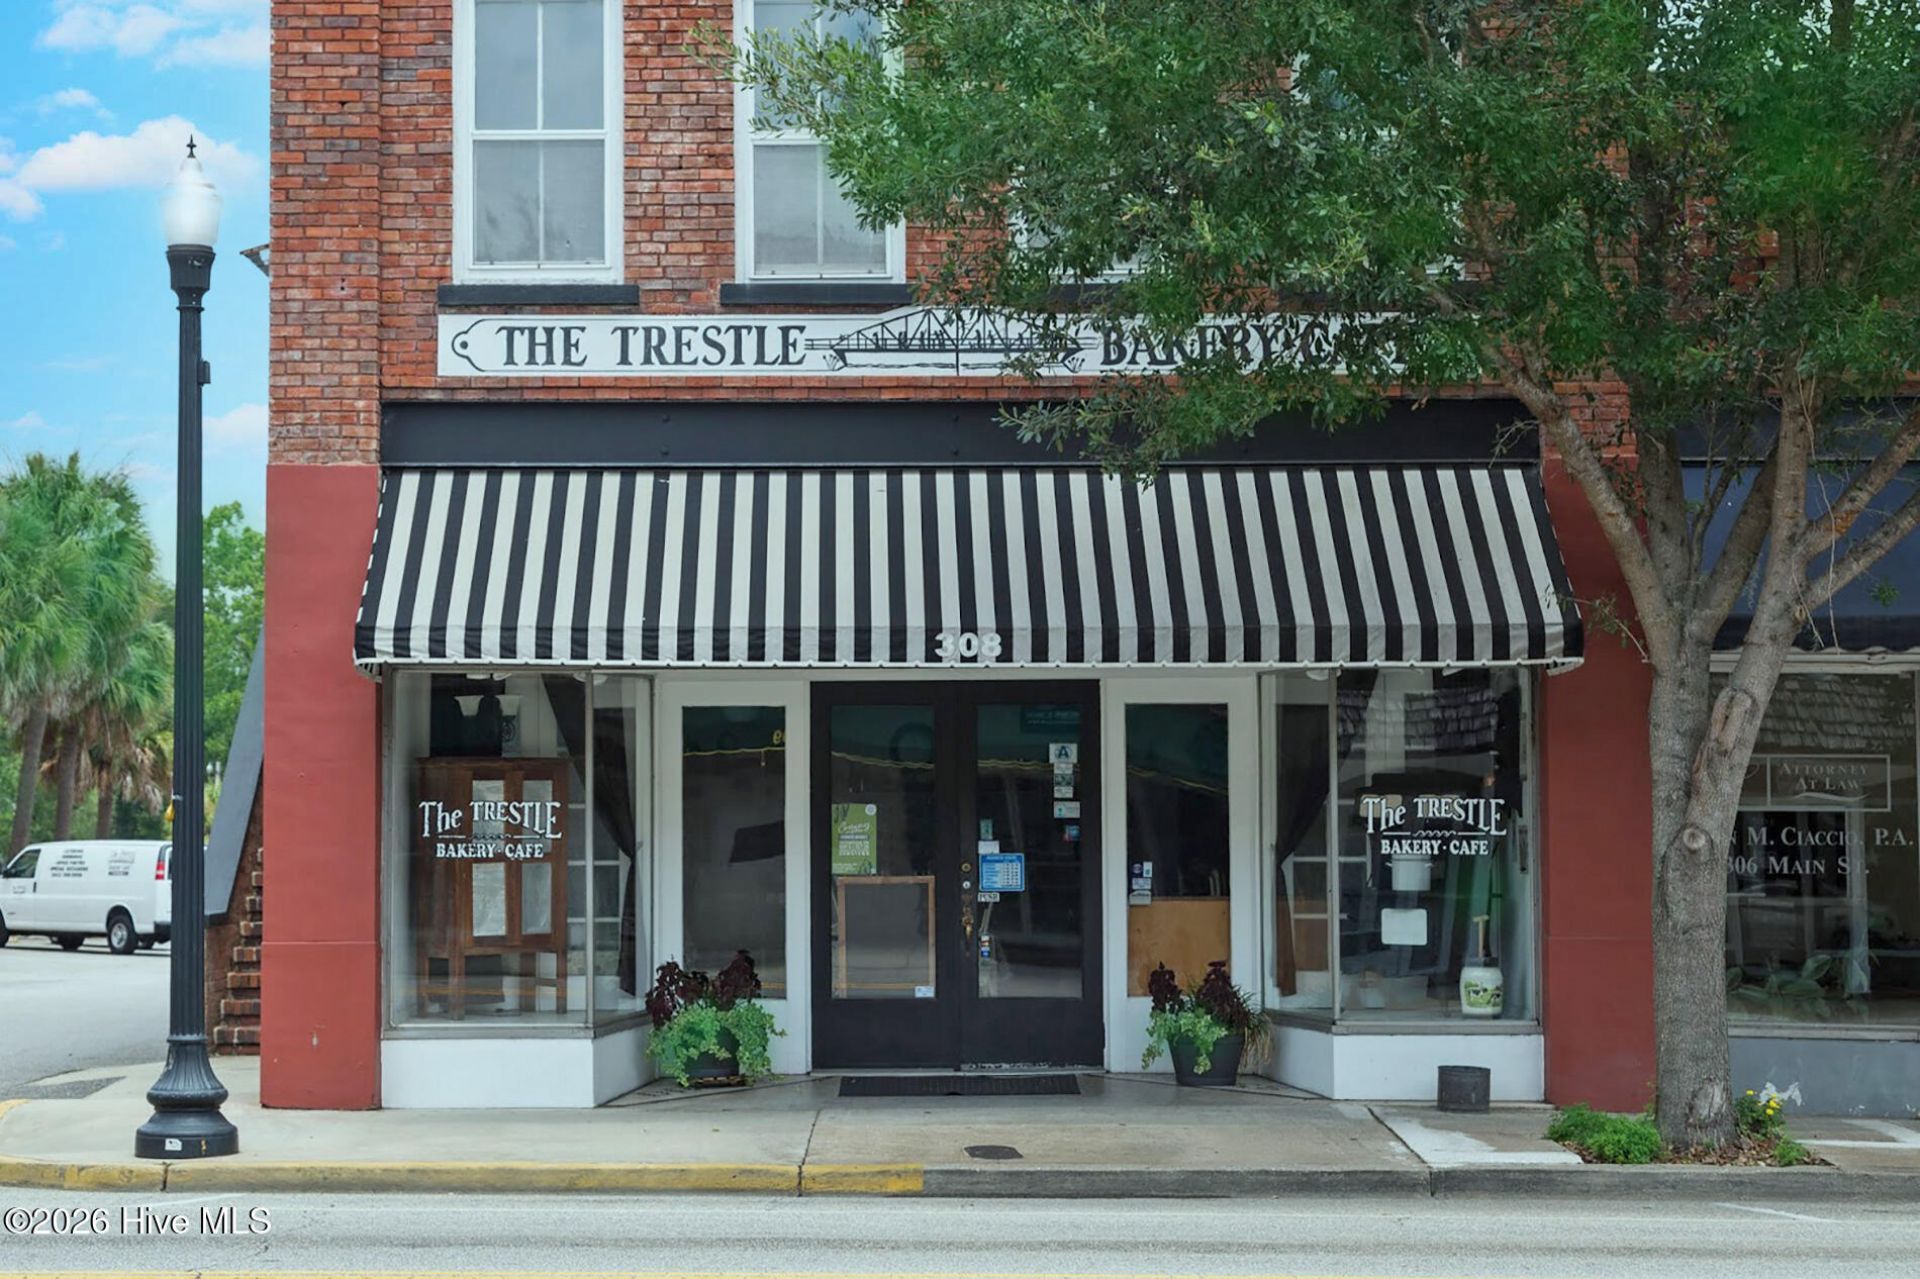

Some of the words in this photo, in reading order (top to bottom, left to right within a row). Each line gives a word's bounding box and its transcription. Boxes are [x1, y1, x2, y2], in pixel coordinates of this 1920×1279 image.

[496, 325, 588, 367] THE
[611, 325, 806, 367] TRESTLE
[934, 632, 1002, 658] 308
[1780, 762, 1868, 776] ATTORNEY
[1795, 778, 1818, 791] AT
[1825, 777, 1859, 791] LAW
[419, 801, 463, 837] The
[469, 801, 562, 838] TRESTLE
[1363, 798, 1407, 834] The
[1413, 798, 1507, 836] TRESTLE
[1748, 826, 1775, 846] M.
[1873, 827, 1914, 846] P.A.
[436, 843, 496, 858] BAKERY
[504, 843, 544, 858] CAFE
[1381, 839, 1441, 855] BAKERY
[1449, 839, 1489, 855] CAFE
[1768, 856, 1826, 875] MAIN
